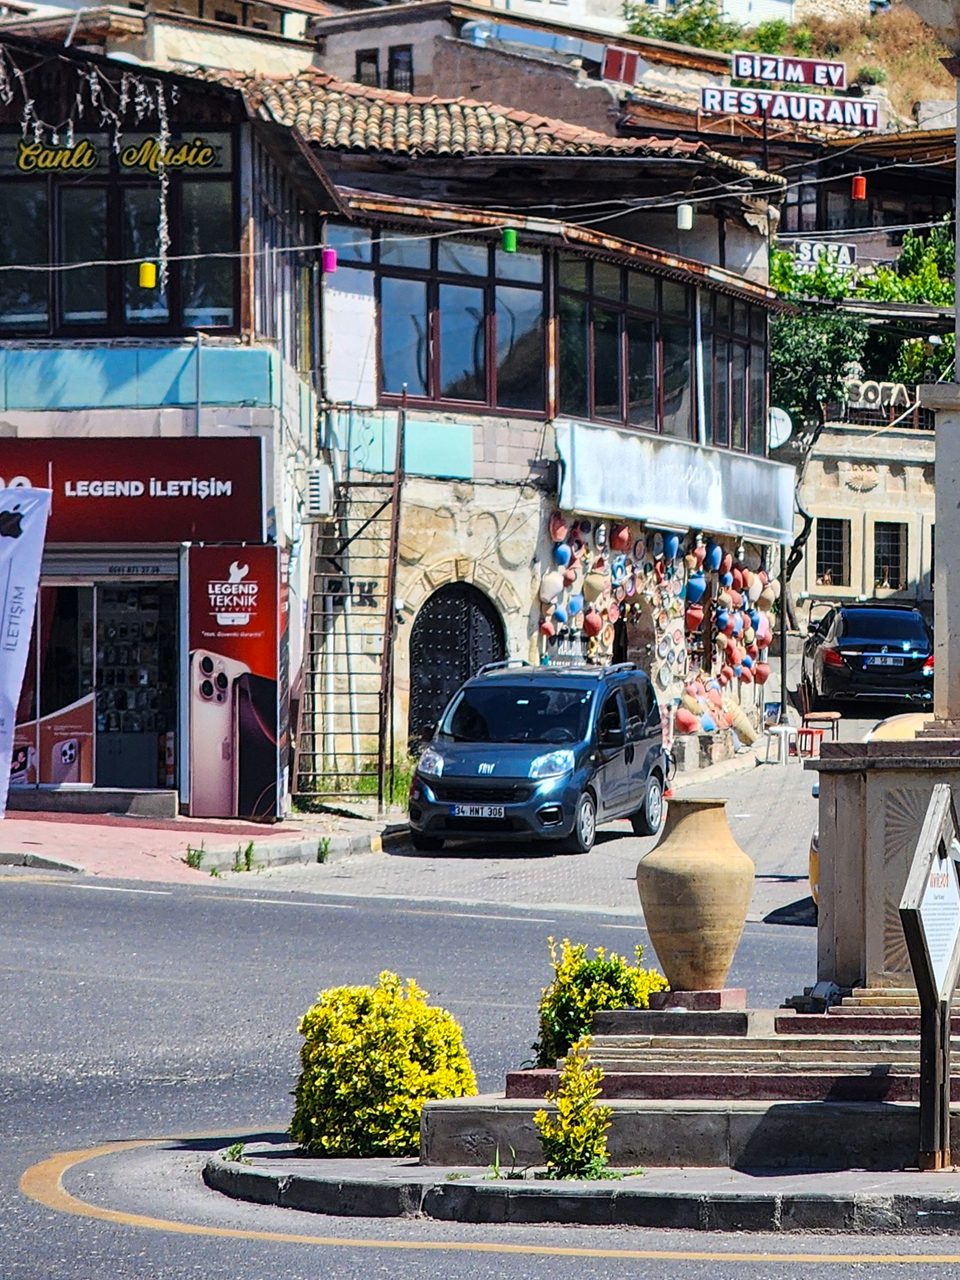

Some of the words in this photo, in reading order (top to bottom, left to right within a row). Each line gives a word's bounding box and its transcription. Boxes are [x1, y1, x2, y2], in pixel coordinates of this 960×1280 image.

[737, 55, 805, 83] BİZİM
[814, 65, 843, 86] EV
[703, 89, 877, 126] RESTAURANT
[121, 139, 215, 172] Music
[799, 242, 851, 265] SOFA
[845, 380, 910, 407] SOFA
[64, 480, 145, 497] LEGEND
[150, 477, 232, 500] İLETİŞİM
[207, 583, 259, 594] LEGEND
[455, 806, 466, 816] 34
[487, 807, 503, 817] 306
